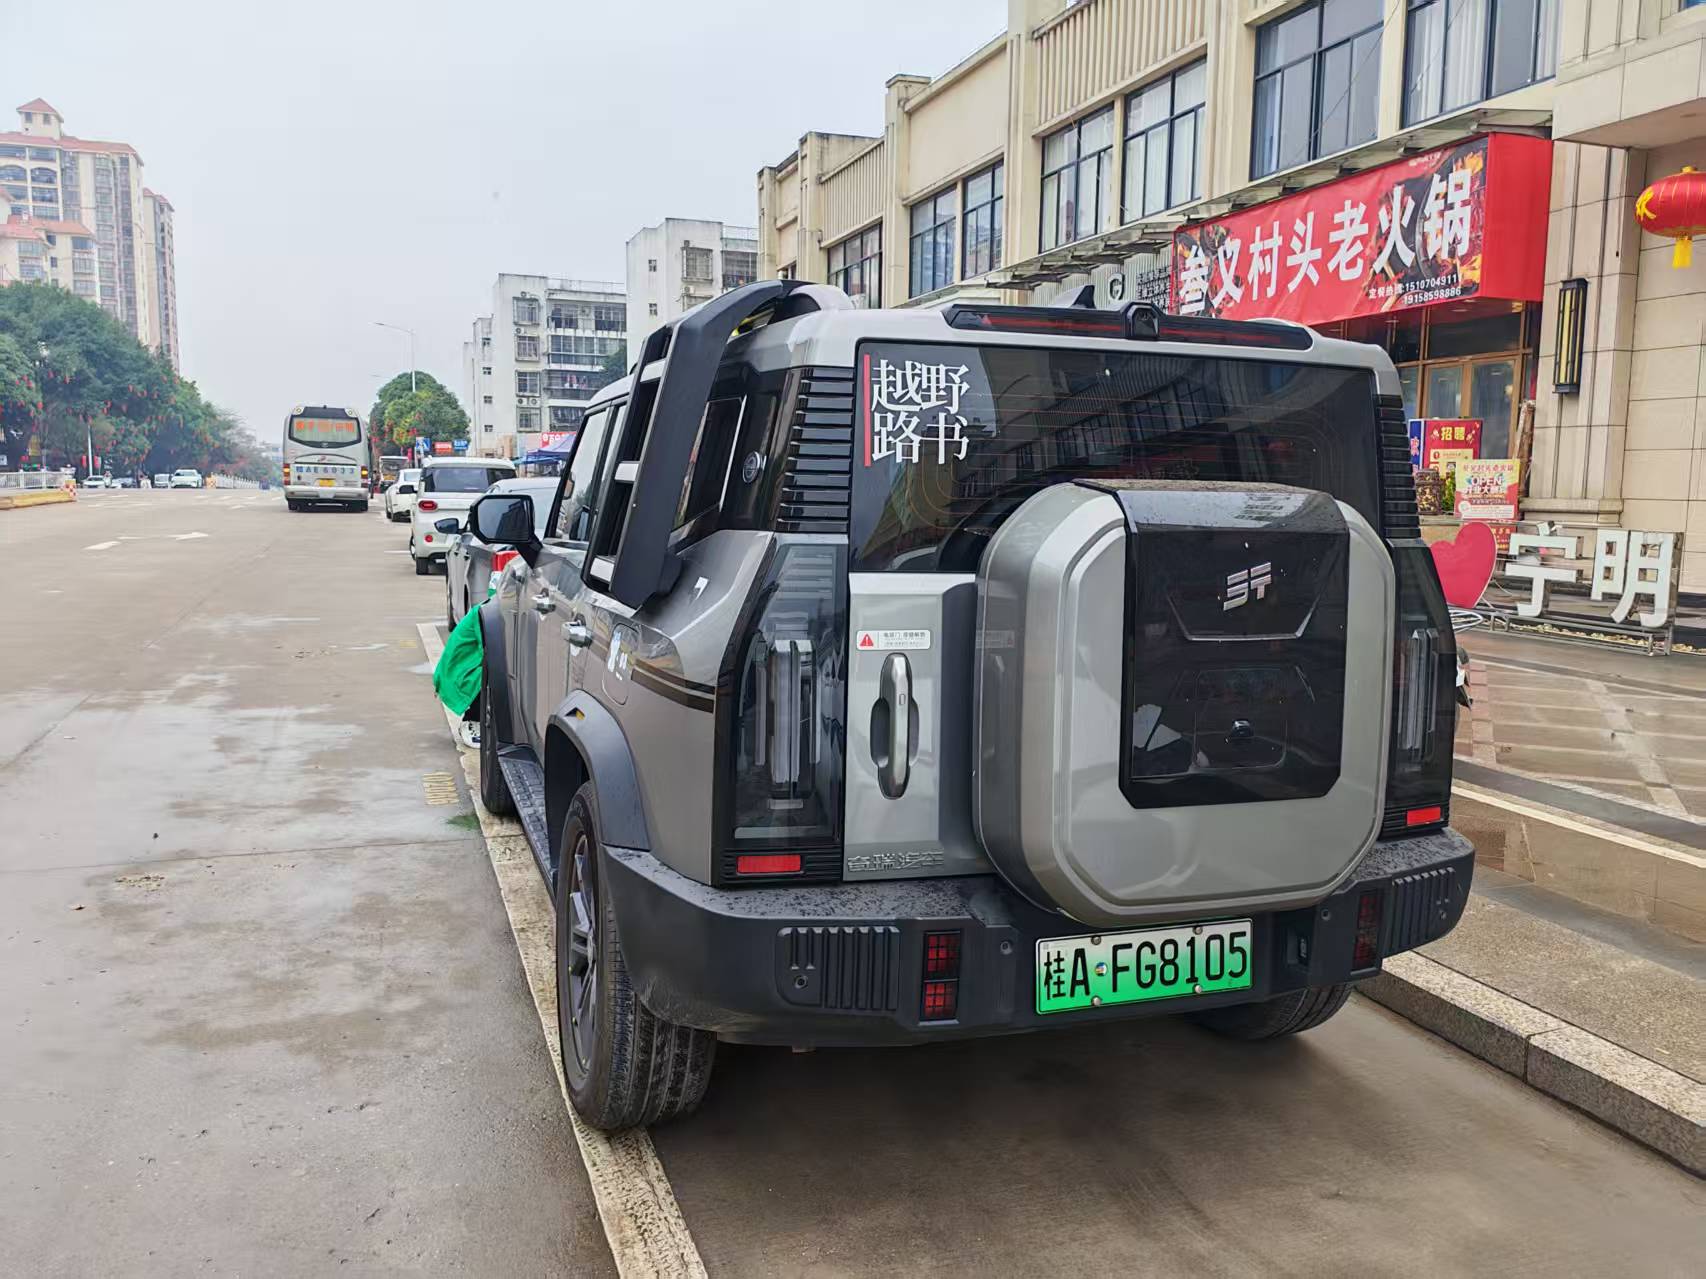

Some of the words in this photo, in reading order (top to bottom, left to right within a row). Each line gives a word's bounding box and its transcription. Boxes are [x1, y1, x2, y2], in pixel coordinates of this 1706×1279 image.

[871, 359, 970, 412] 越野
[871, 412, 970, 464] 路书
[1440, 426, 1466, 441] 招聘
[1470, 475, 1503, 486] OPEN
[1505, 521, 1674, 629] 宁明
